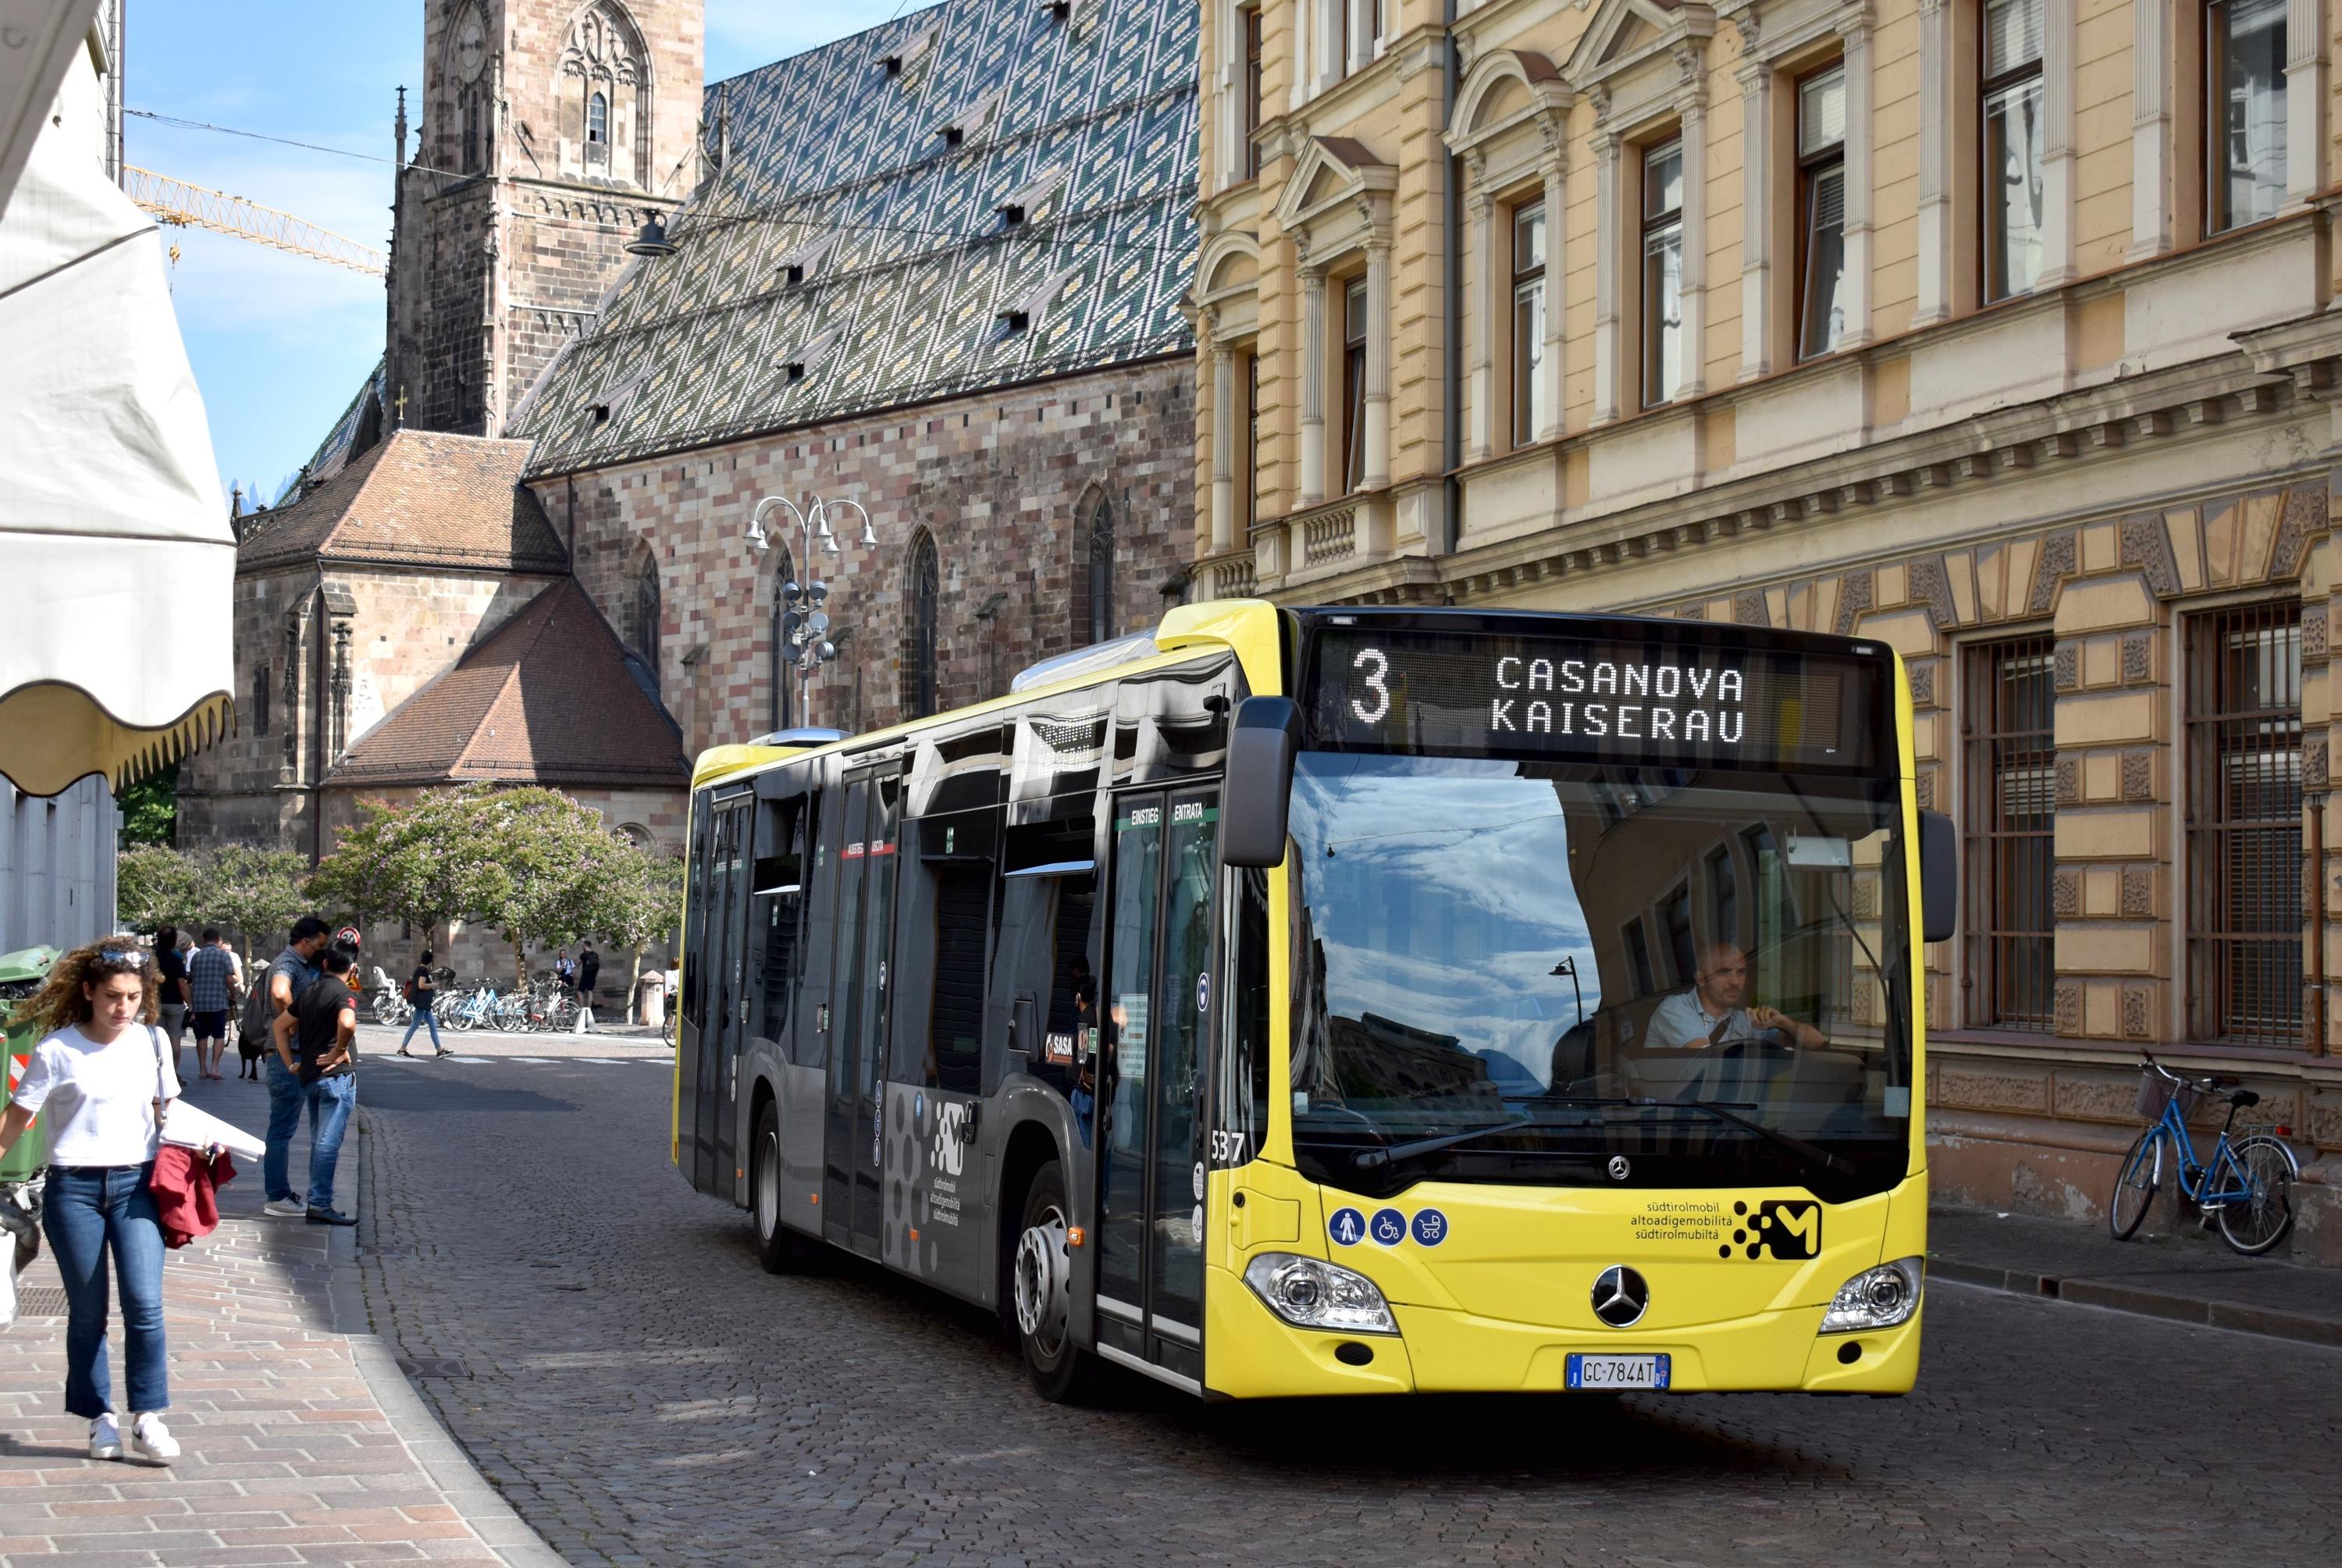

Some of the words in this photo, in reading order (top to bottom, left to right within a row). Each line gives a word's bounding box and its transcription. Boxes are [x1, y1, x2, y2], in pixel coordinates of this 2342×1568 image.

[1352, 649, 1389, 723] 3
[1497, 656, 1743, 701] CASANOVA
[1492, 699, 1743, 742] KAISERAU
[1131, 807, 1159, 826] EINSTIEG
[1174, 802, 1203, 821] ENTRATA
[1053, 1035, 1073, 1055] SASA
[1212, 1129, 1244, 1162] 537
[1647, 1201, 1720, 1212] südtirolmobil
[1631, 1214, 1733, 1228] altoadigemobilità
[1635, 1229, 1719, 1240] südtirolmubiltà
